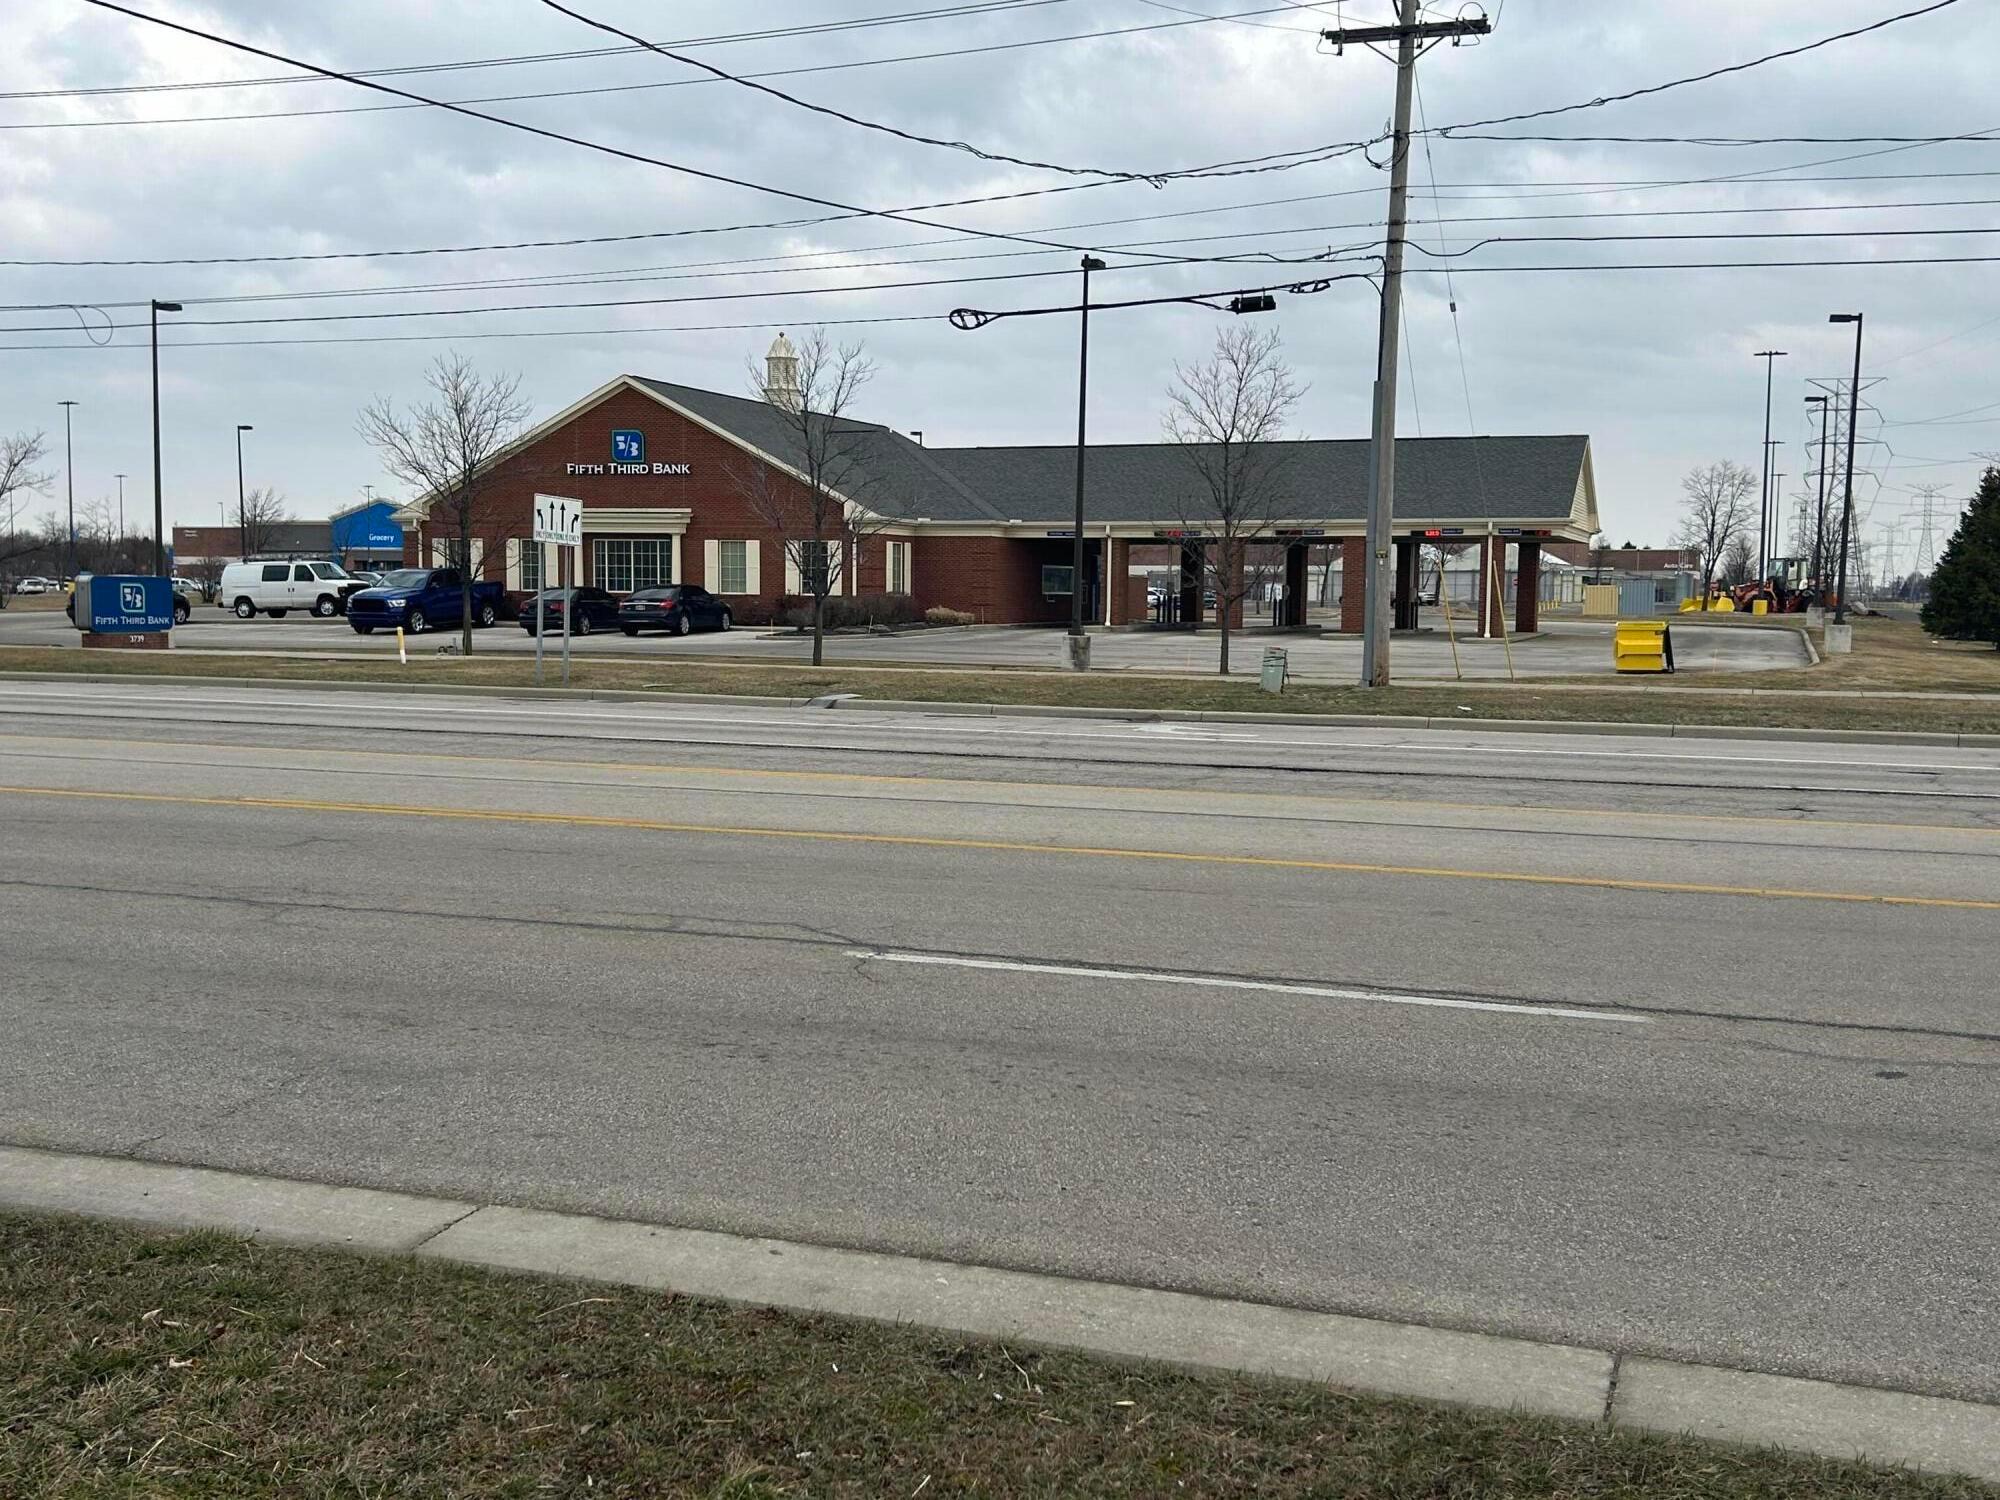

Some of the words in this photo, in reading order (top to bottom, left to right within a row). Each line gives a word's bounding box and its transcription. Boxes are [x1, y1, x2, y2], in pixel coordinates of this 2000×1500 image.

[567, 463, 604, 475] FIFTH
[608, 463, 649, 475] THIRD
[653, 463, 691, 475] BANK
[368, 533, 395, 543] Grocery
[95, 616, 118, 625] FIFTH
[120, 616, 146, 625] THIRD
[148, 616, 170, 625] BANK
